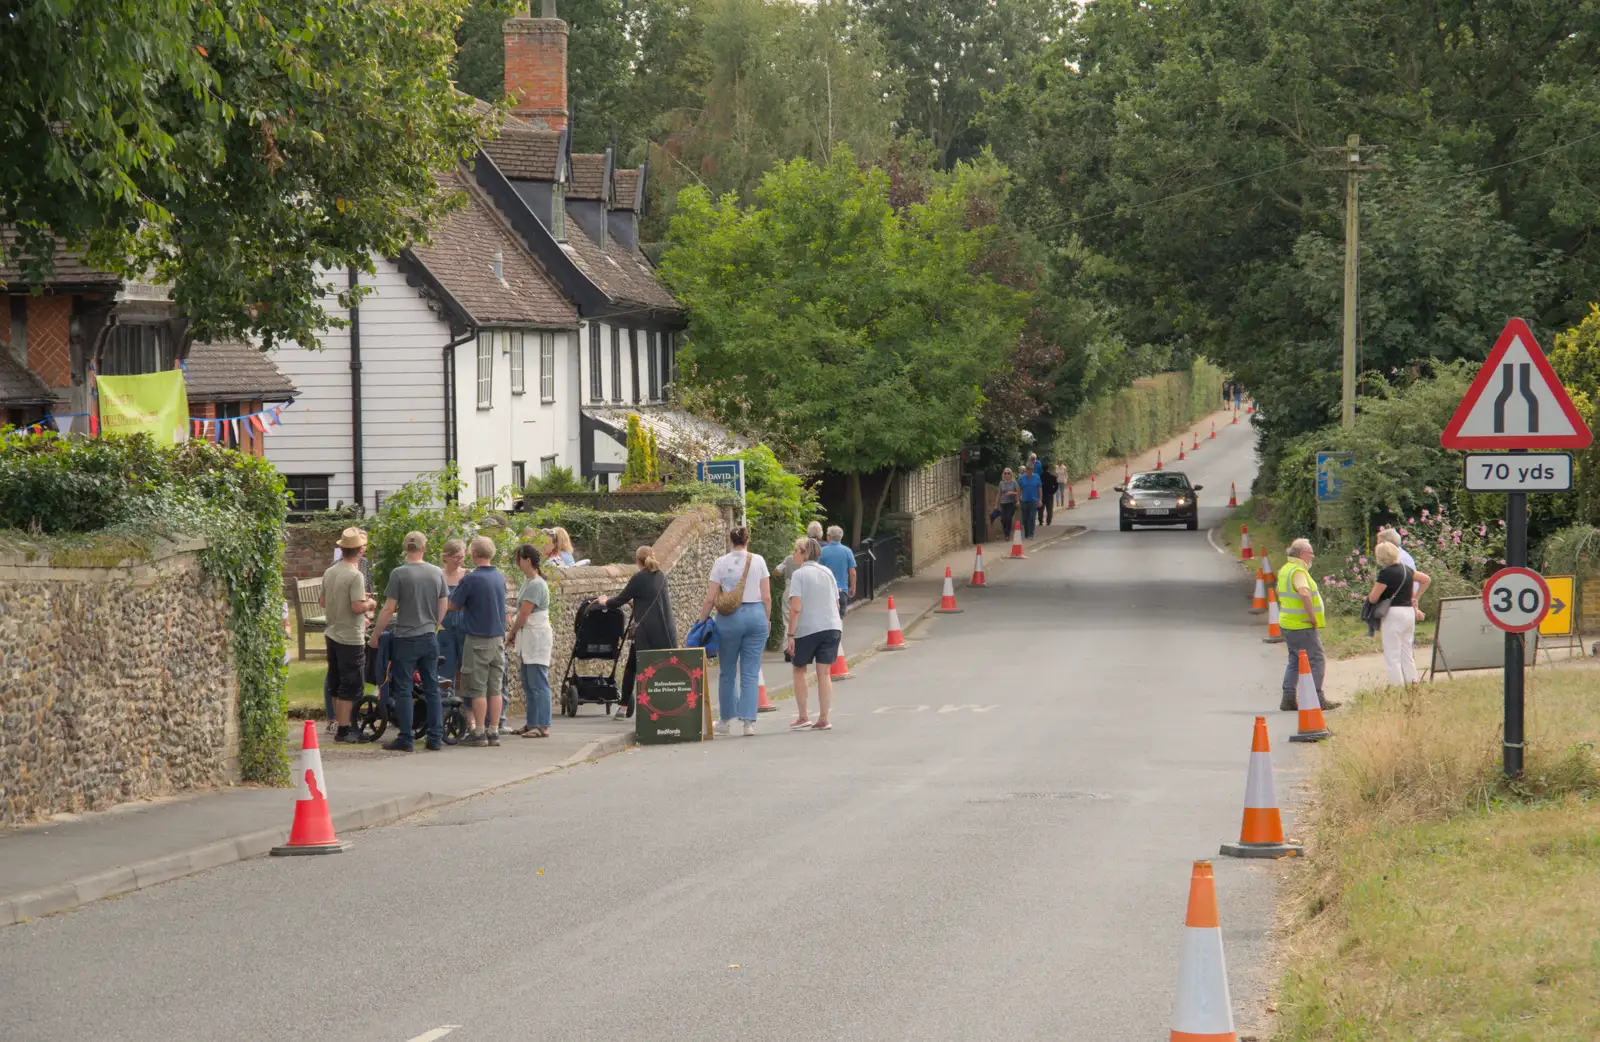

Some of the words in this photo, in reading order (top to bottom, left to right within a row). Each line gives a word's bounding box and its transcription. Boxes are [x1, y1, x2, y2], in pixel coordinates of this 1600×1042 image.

[1481, 463, 1510, 480] 70
[1518, 463, 1554, 483] yds
[1493, 587, 1539, 613] 30
